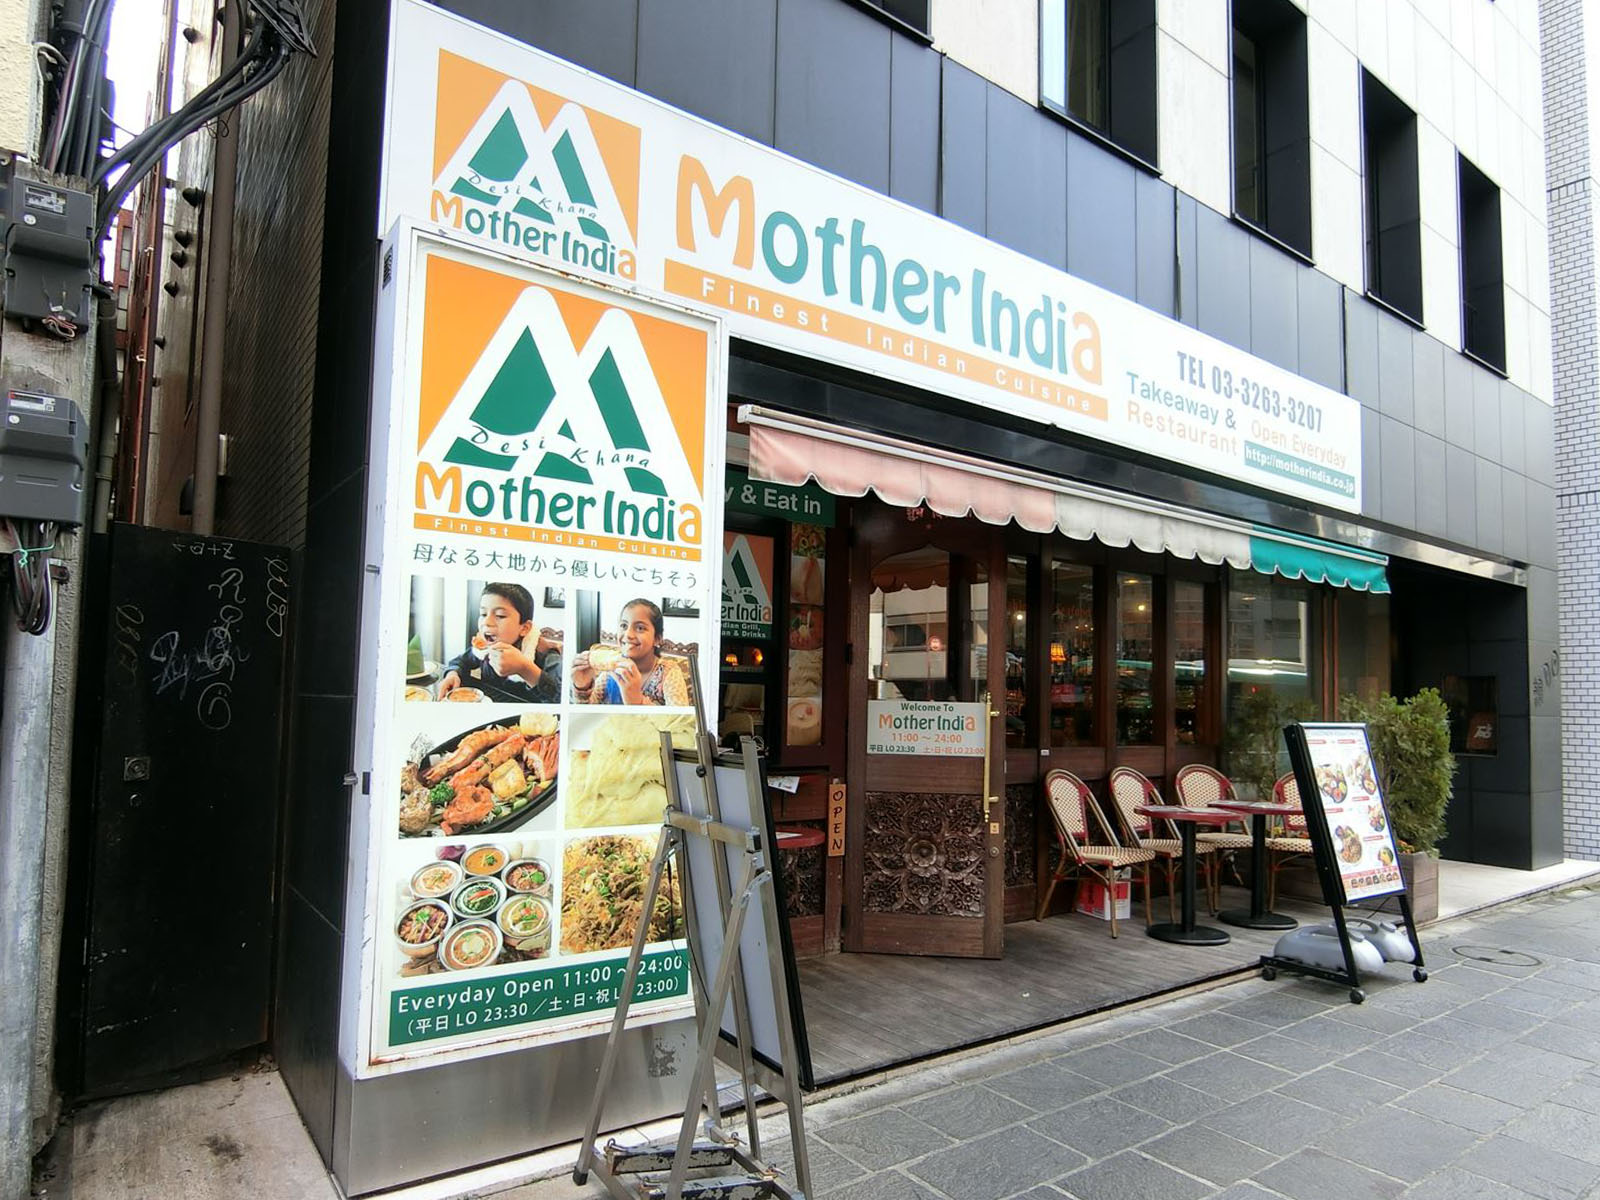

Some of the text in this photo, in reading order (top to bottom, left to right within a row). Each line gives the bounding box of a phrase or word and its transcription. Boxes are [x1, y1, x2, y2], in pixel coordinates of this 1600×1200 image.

[468, 170, 598, 220] Desi Khana
[702, 276, 1091, 412] Finest Indian Cuisine
[1126, 371, 1237, 430] Takeaway &
[1177, 350, 1323, 434] TEL 03-3263-3207
[471, 425, 650, 467] Desi Khana
[1127, 400, 1238, 456] Restaurant
[1250, 418, 1347, 470] Open Everyday
[1245, 446, 1355, 496] http://motherindia.co.jp
[740, 484, 757, 505] &
[763, 488, 798, 512] Eat
[804, 495, 820, 515] in
[434, 518, 689, 559] Finest Indian Cuisine
[412, 542, 698, 589] 母なる大地から優しいごちそう
[741, 630, 766, 639] Drinks
[900, 702, 954, 712] Welcome To
[885, 744, 895, 752] LO
[896, 745, 916, 753] 23:30
[892, 733, 919, 743] 11:00
[934, 733, 962, 744] 24:00
[832, 790, 844, 851] OPEN
[397, 984, 496, 1015] Everyday
[504, 977, 554, 999] Open
[563, 964, 612, 989] 11:00
[636, 955, 682, 977] 24:00
[456, 1010, 477, 1028] LO
[484, 1003, 529, 1022] 23:30
